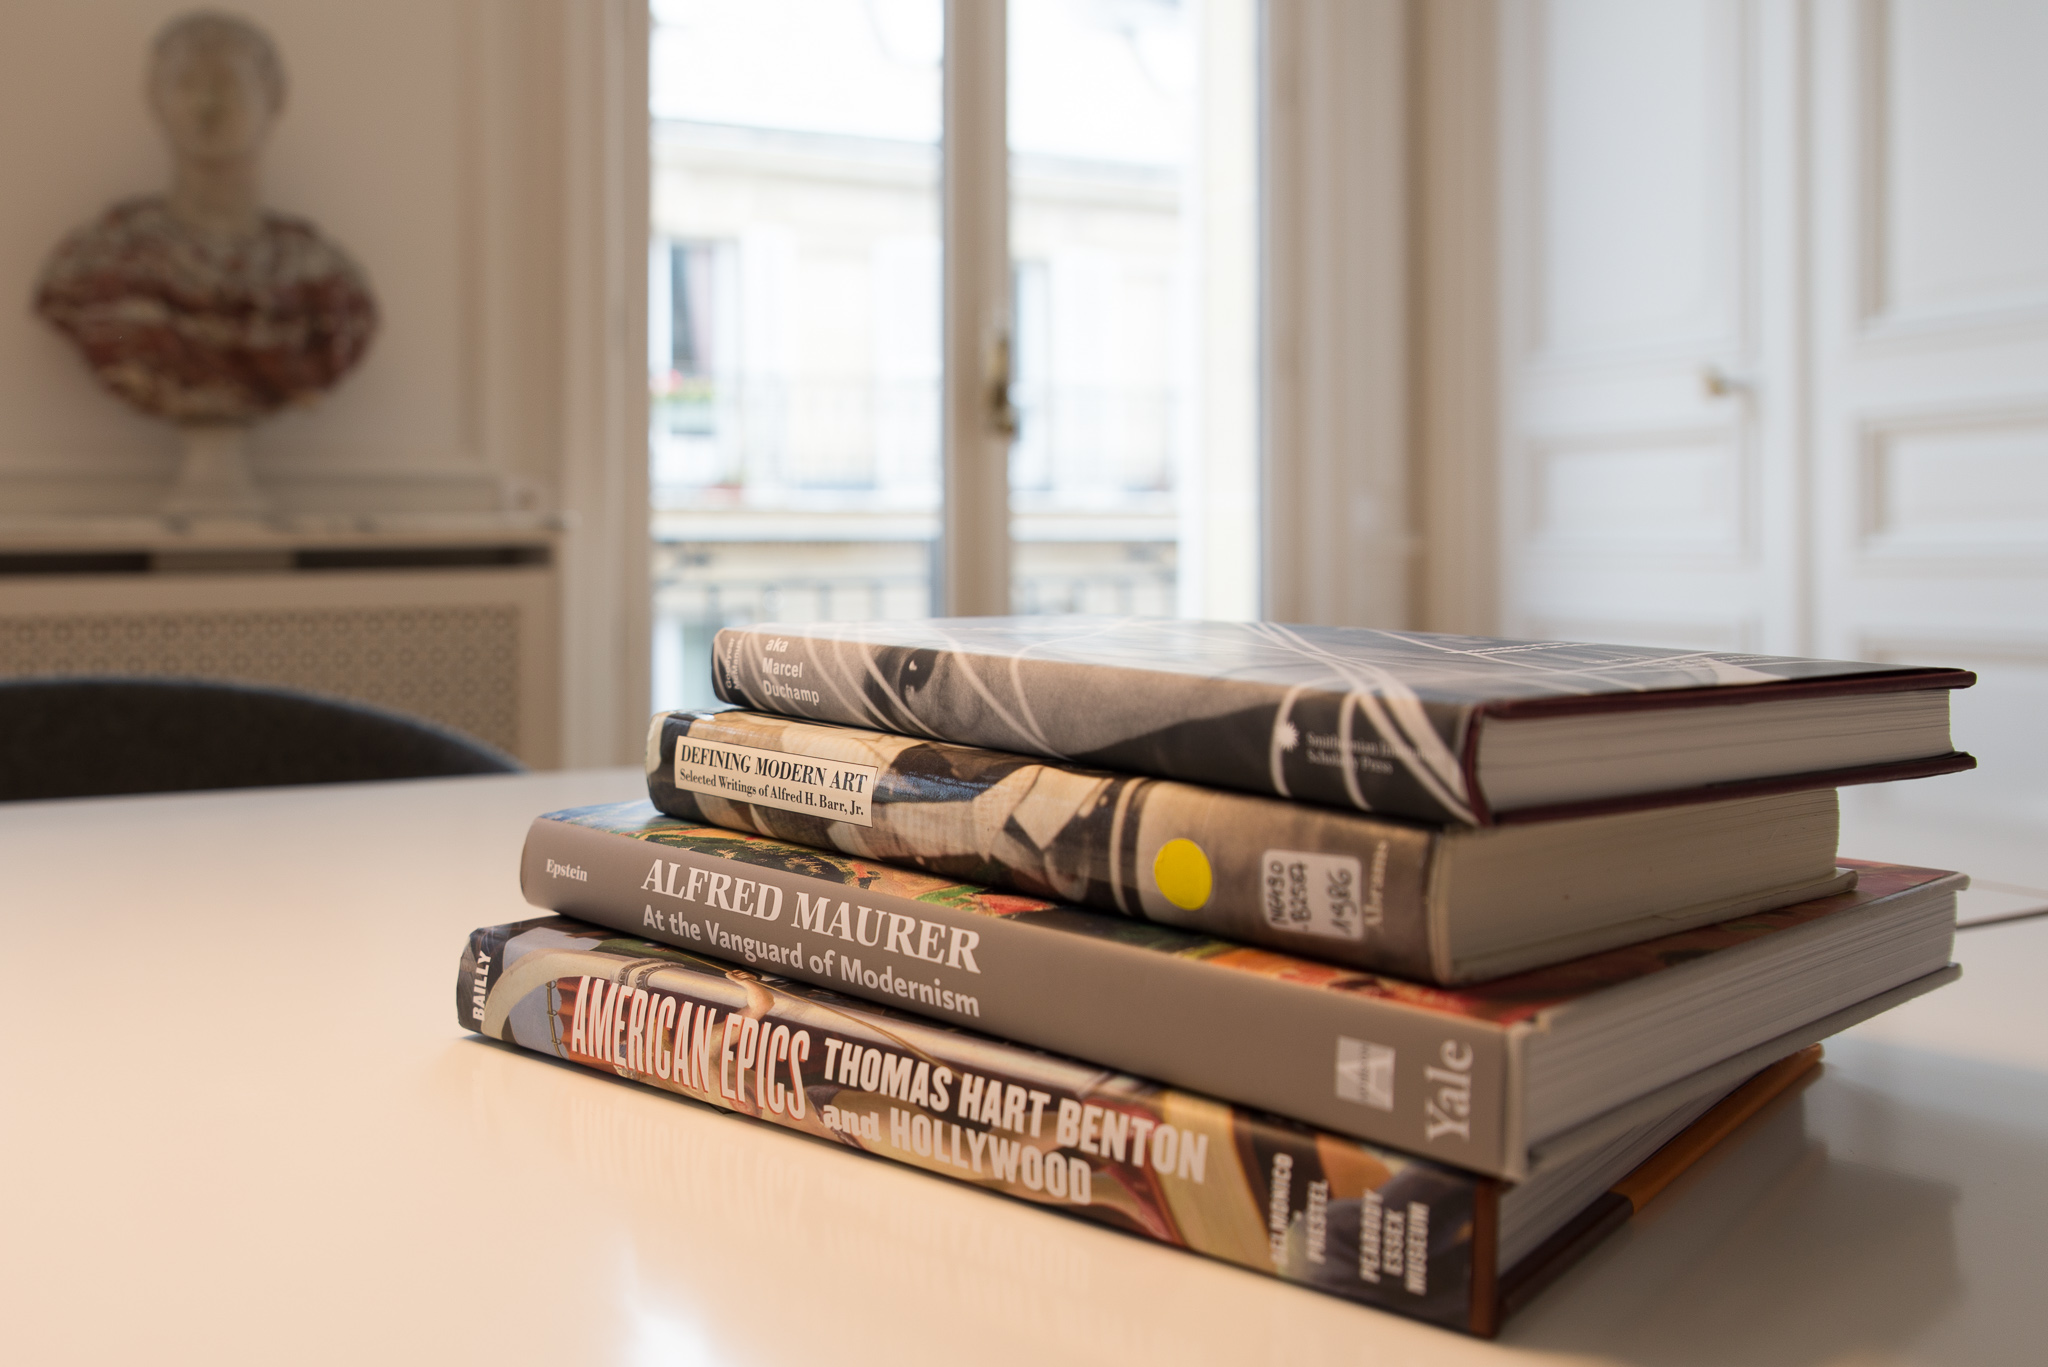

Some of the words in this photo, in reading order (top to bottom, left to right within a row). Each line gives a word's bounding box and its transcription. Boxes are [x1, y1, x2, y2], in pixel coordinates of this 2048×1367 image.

[762, 657, 803, 678] Marcel
[765, 637, 789, 653] aka
[762, 679, 820, 706] Duchamp
[680, 768, 716, 787] Selected
[718, 775, 756, 797] Writings
[758, 784, 770, 797] of
[770, 786, 802, 804] Alfred
[805, 792, 817, 807] H.
[819, 795, 847, 816] Barr,
[850, 801, 864, 816] Jr.
[681, 744, 751, 773] DEFINING
[755, 757, 827, 787] MODERN
[829, 770, 868, 794] ART
[546, 858, 588, 882] Epstein
[1324, 868, 1358, 936] 1986
[640, 857, 783, 922] ALFRED
[790, 892, 981, 975] MAURER
[472, 950, 492, 1022] BAILLY
[643, 904, 666, 931] At
[669, 908, 701, 941] the
[704, 919, 803, 964] Vanguard
[810, 949, 836, 977] of
[840, 955, 981, 1018] Modernism
[571, 975, 717, 1094] AMERICAN
[719, 1012, 811, 1122] EPICS
[823, 1037, 954, 1113] THOMAS
[957, 1073, 1051, 1139] HART
[1056, 1097, 1209, 1185] BENTON
[1425, 1039, 1474, 1142] Yale
[822, 1103, 882, 1143] and
[889, 1107, 1092, 1205] HOLLYWOOD
[1359, 1189, 1383, 1284] PEABODY
[1382, 1208, 1405, 1278] ESSEX
[1404, 1201, 1430, 1297] MUSEUM
